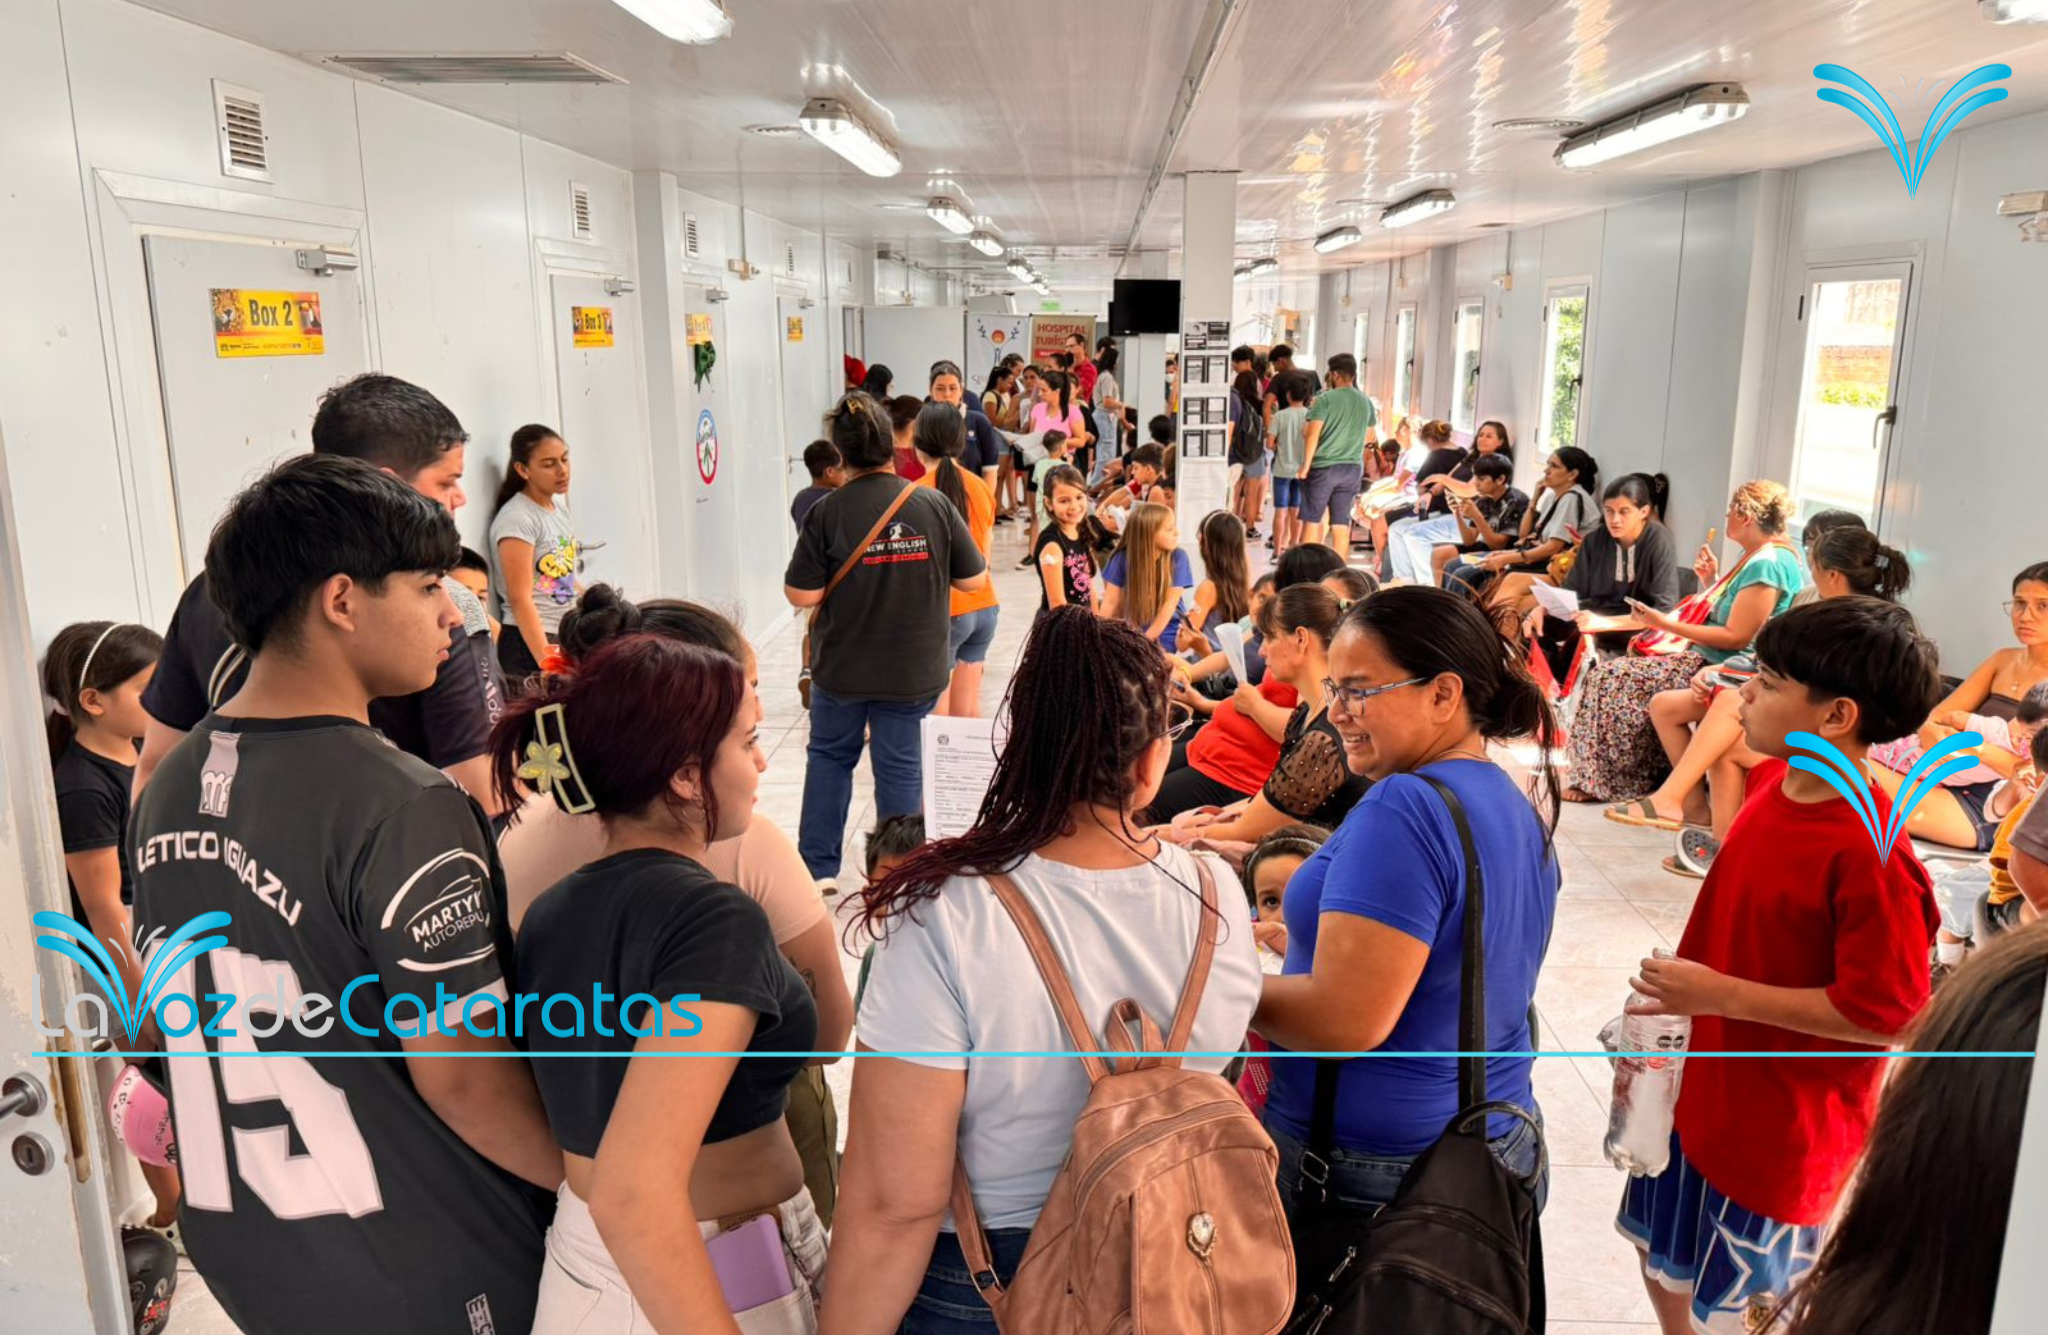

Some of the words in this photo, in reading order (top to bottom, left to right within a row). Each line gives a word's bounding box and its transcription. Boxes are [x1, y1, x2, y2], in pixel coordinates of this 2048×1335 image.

[248, 298, 279, 327] Box
[282, 300, 294, 327] 2
[585, 313, 597, 330] Box
[1036, 334, 1066, 346] TURÍS
[1037, 323, 1086, 334] HOSPITAL
[887, 539, 927, 550] ENGLISH
[137, 831, 220, 873] LETICO
[223, 836, 303, 927] IGUAZU
[423, 910, 485, 953] AUTOREPU
[143, 937, 385, 1220] 15
